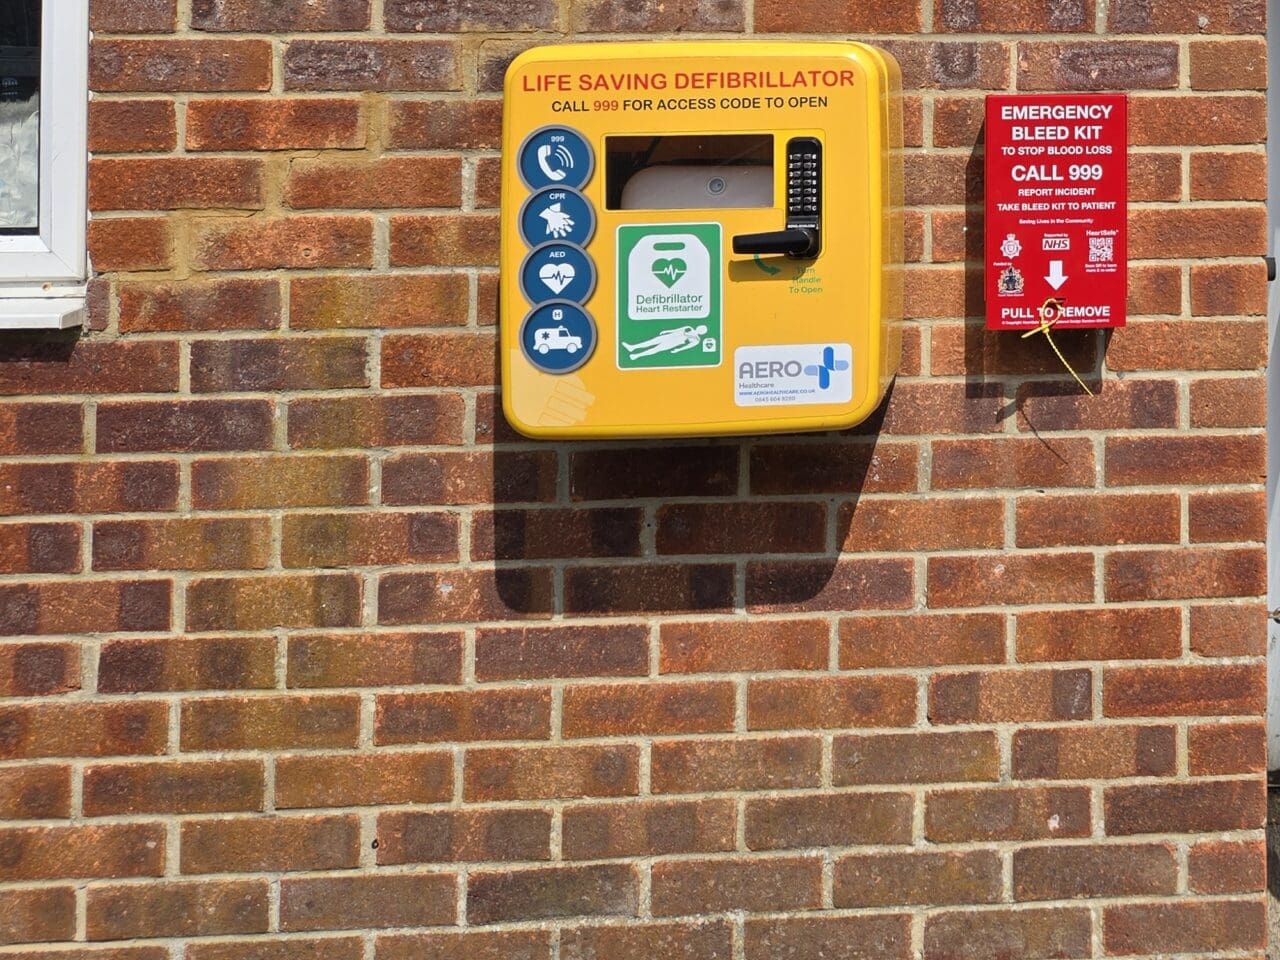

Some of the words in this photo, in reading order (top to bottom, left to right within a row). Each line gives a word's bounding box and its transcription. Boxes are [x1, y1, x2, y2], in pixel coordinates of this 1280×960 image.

[523, 74, 572, 92] LIFE
[579, 72, 667, 91] SAVING
[674, 70, 855, 90] DEFIBRILLATOR
[551, 99, 590, 113] CALL
[593, 99, 619, 112] 999
[623, 98, 653, 112] FOR
[656, 97, 717, 111] ACCESS
[720, 96, 762, 110] CODE
[764, 96, 784, 109] TO
[787, 95, 829, 109] OPEN
[1001, 105, 1113, 120] EMERGENCY
[1011, 126, 1070, 140] BLEED
[1074, 125, 1102, 140] KIT
[1001, 146, 1015, 155] TO
[1017, 146, 1045, 155] STOP
[1047, 146, 1083, 155] BLOOD
[1085, 145, 1112, 155] LOSS
[1011, 165, 1064, 181] CALL
[1068, 164, 1103, 181] 999
[1018, 188, 1053, 197] REPORT
[1055, 187, 1096, 196] INCIDENT
[997, 203, 1019, 211] TAKE
[1021, 203, 1050, 211] BLEED
[1052, 202, 1066, 210] KIT
[1068, 202, 1079, 210] TO
[1081, 201, 1116, 210] PATIENT
[1043, 239, 1069, 249] NHS
[801, 286, 823, 295] Open
[636, 294, 703, 305] Defibrillator
[636, 305, 661, 314] Heart
[662, 304, 703, 313] Restarter
[1001, 307, 1034, 318] PULL
[1037, 307, 1054, 318] TO
[1057, 305, 1111, 317] REMOVE
[739, 360, 802, 379] AERO
